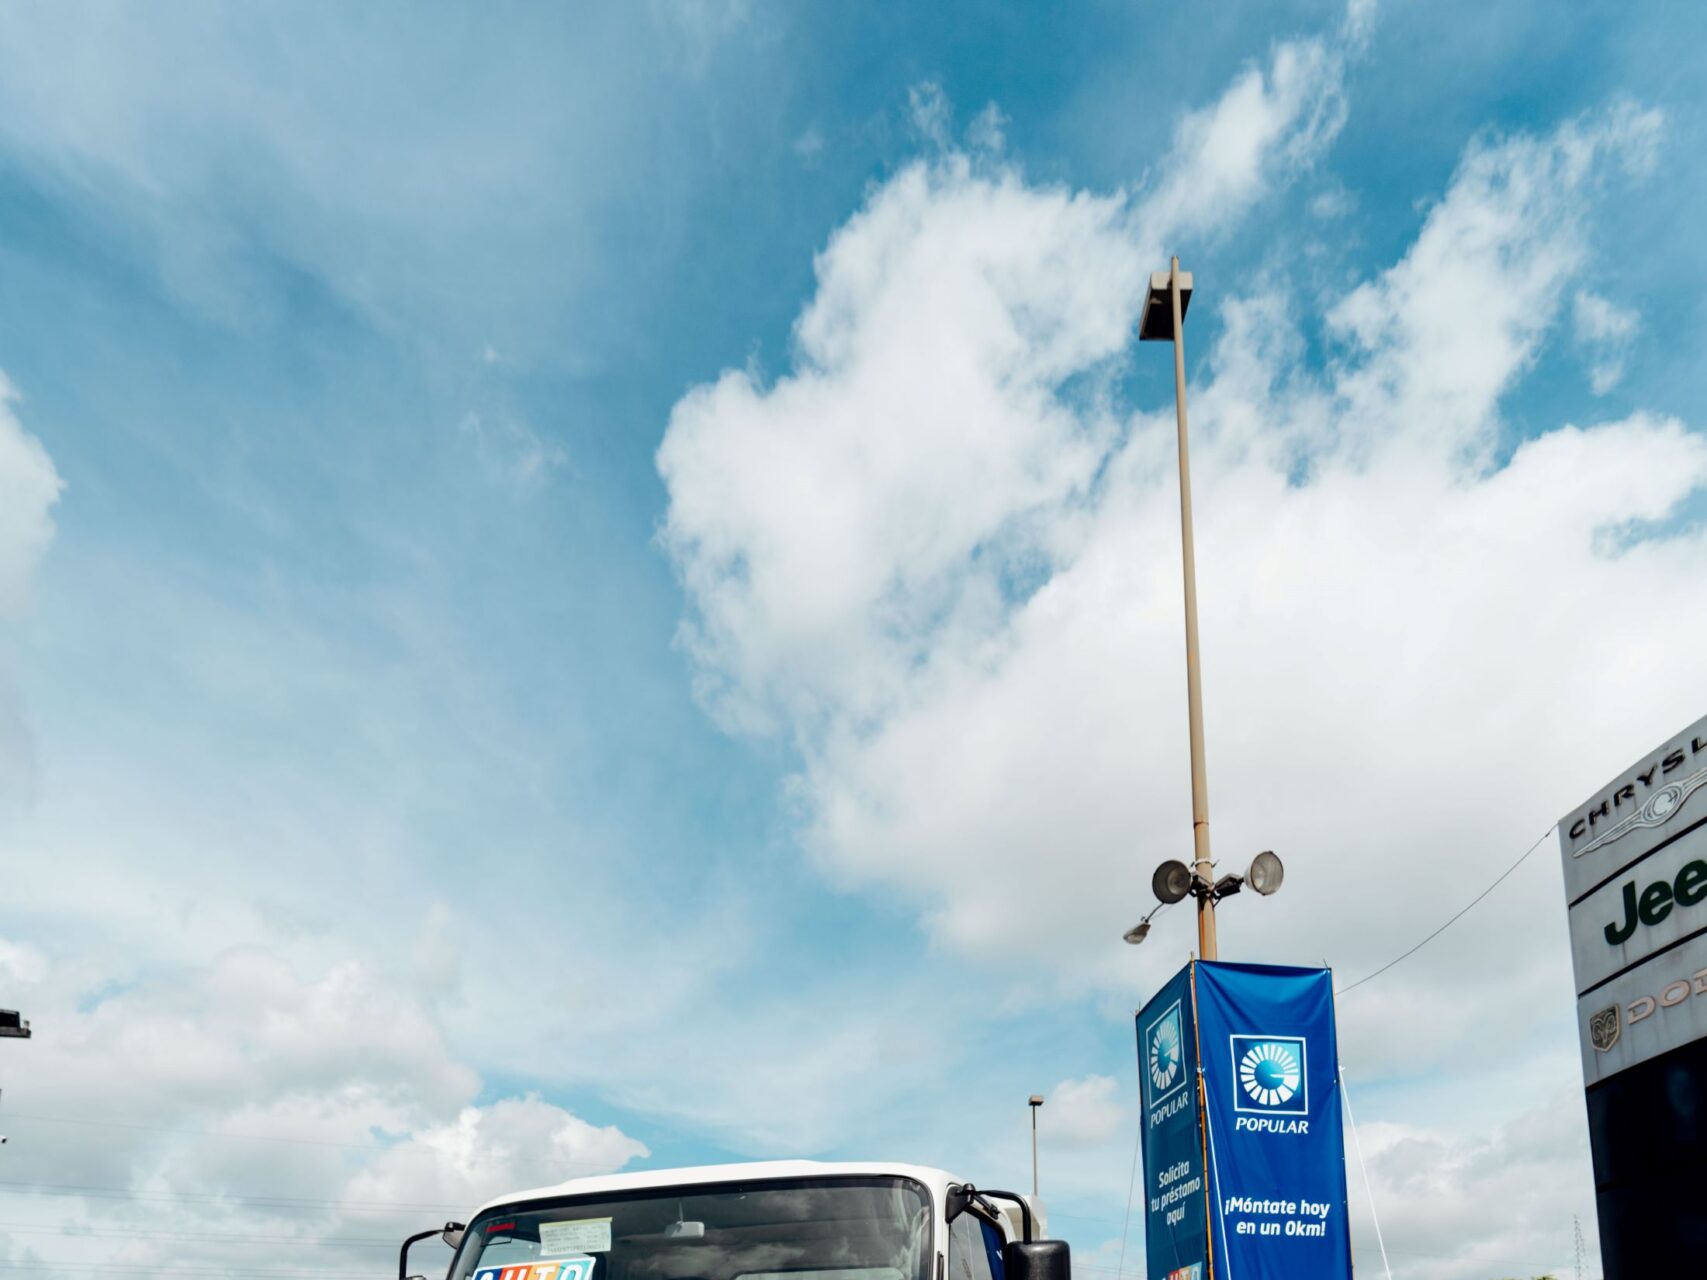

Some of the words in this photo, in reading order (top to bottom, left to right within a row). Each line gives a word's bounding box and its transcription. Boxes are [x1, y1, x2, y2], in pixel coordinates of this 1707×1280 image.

[1604, 859, 1707, 946] Jee
[1151, 1091, 1189, 1128] POPULAR
[1236, 1117, 1309, 1134] POPULAR
[1159, 1160, 1190, 1188] Solicita
[1151, 1197, 1160, 1212] tu
[1161, 1177, 1201, 1211] préstamo
[1225, 1196, 1297, 1215] ¡Móntate
[1301, 1199, 1330, 1219] hoy
[1166, 1201, 1186, 1226] aquí
[1236, 1222, 1256, 1235] en
[1260, 1223, 1281, 1236] un
